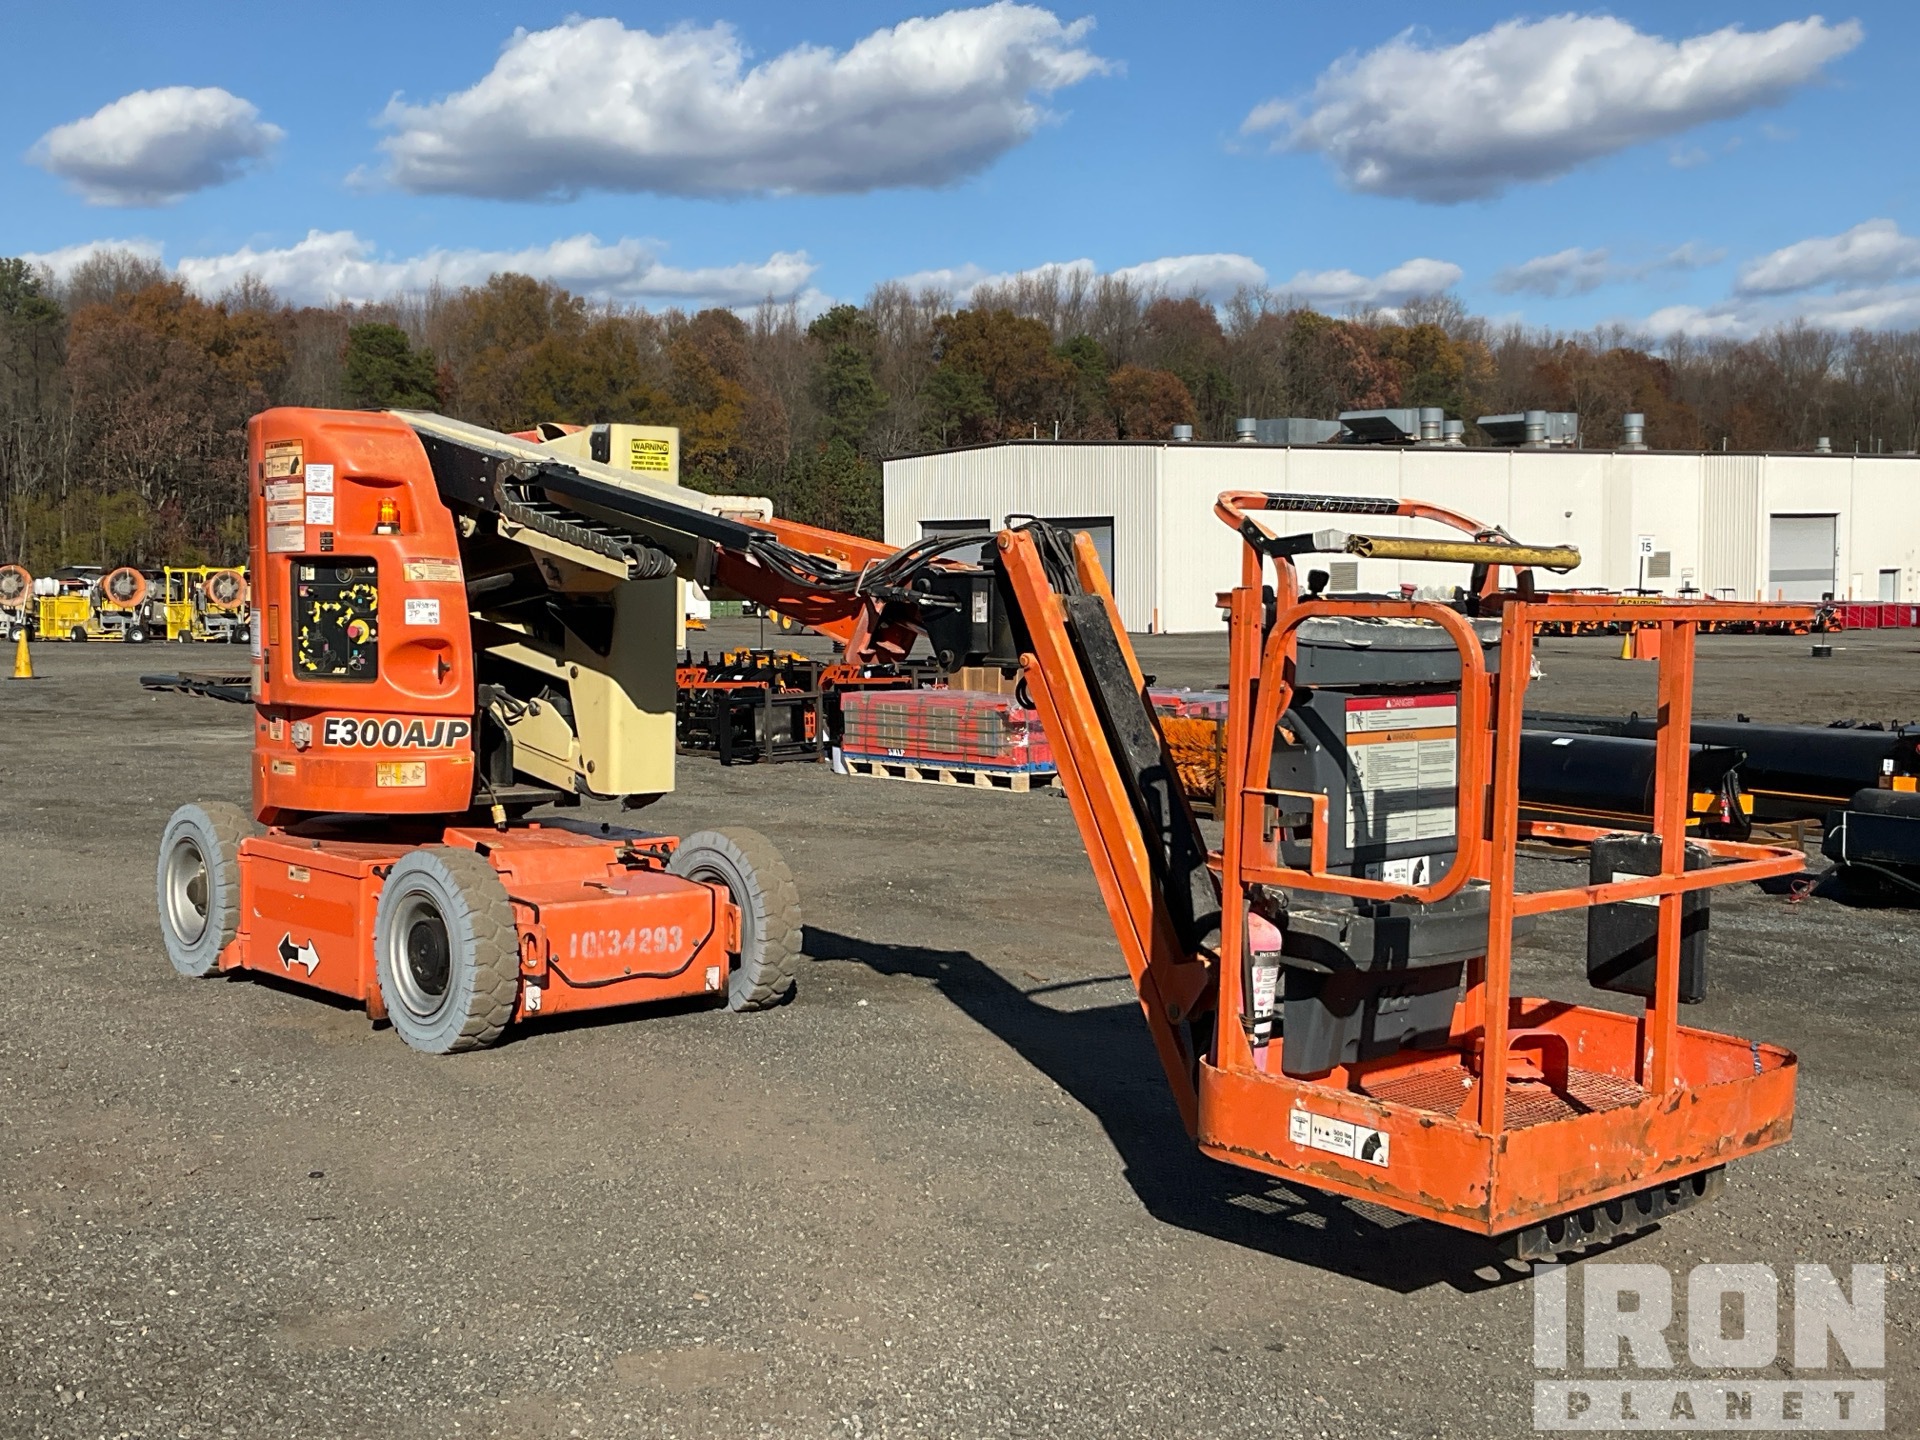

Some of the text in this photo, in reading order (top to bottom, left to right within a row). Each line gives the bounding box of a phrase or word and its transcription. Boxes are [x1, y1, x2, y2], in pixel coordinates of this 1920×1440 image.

[633, 442, 668, 452] WARNING
[1641, 542, 1652, 552] 15
[323, 718, 471, 749] E300AJP
